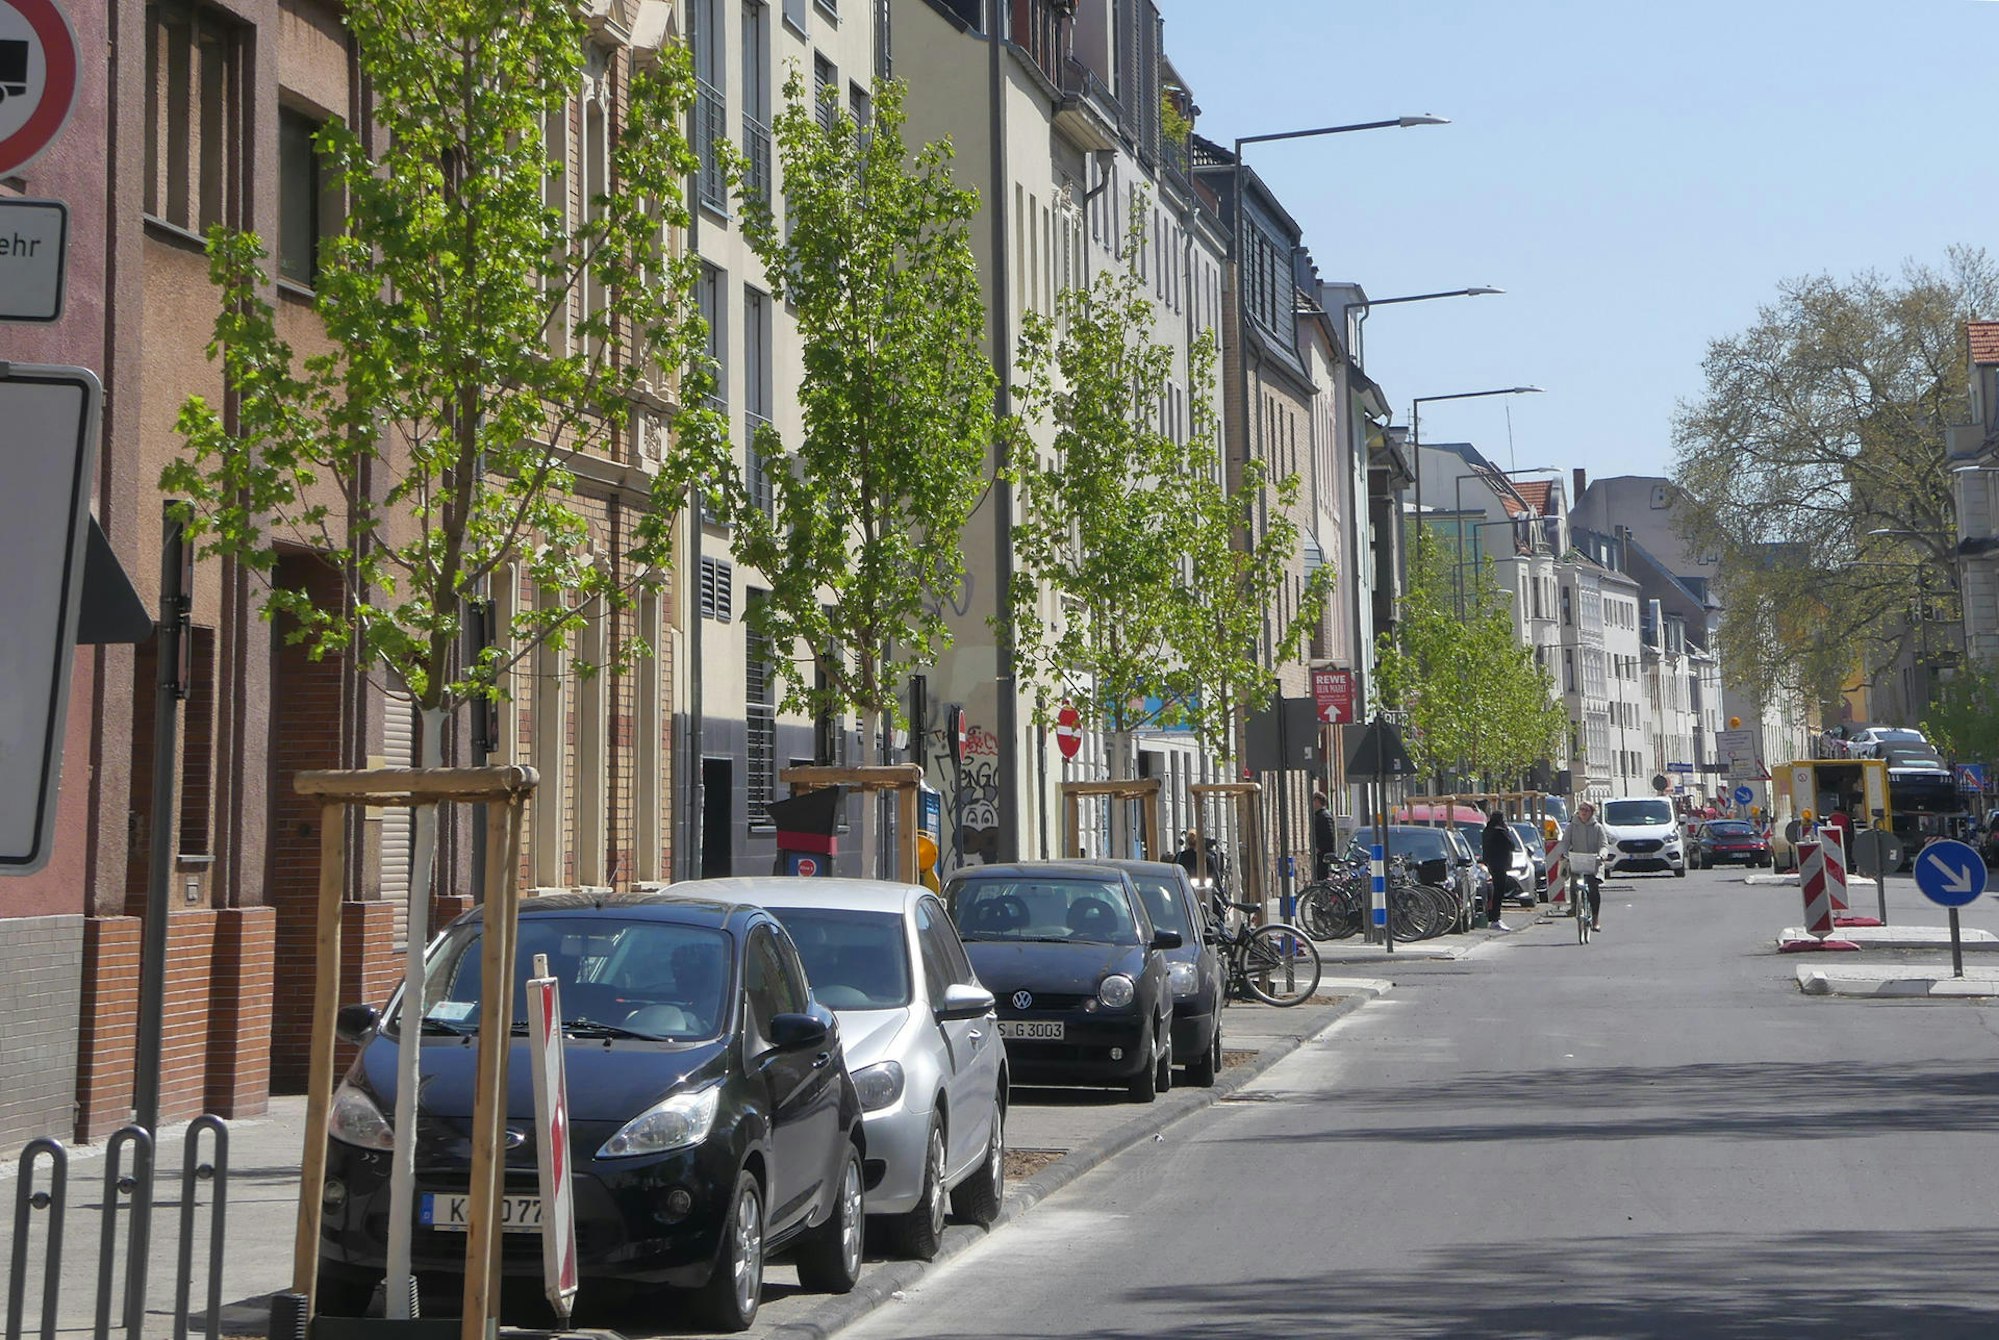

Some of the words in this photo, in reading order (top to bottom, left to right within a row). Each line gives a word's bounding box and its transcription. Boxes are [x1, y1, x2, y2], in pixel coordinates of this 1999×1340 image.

[0, 232, 41, 257] ehr
[1316, 675, 1346, 685] REWE
[1016, 1023, 1024, 1037] G
[1027, 1023, 1062, 1037] 3003
